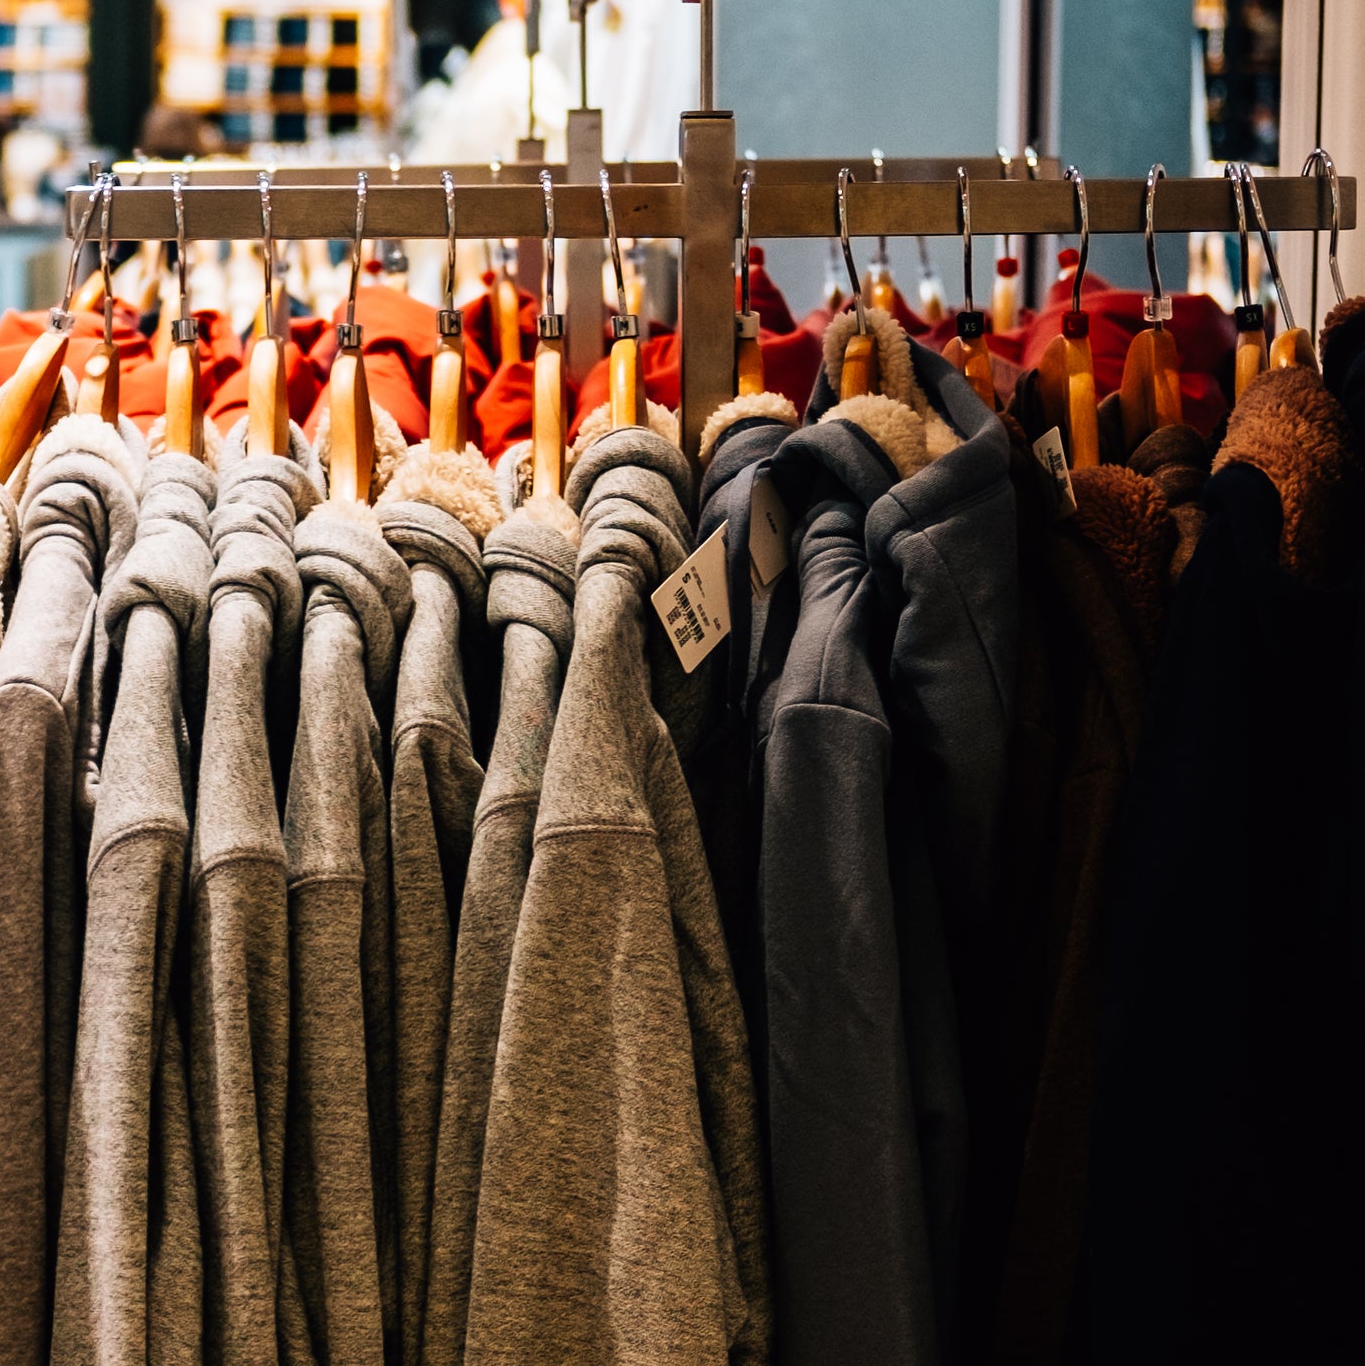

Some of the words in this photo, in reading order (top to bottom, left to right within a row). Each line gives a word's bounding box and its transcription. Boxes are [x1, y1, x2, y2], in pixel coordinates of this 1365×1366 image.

[964, 322, 977, 332] XS
[1067, 321, 1075, 331] L
[682, 572, 691, 584] S
